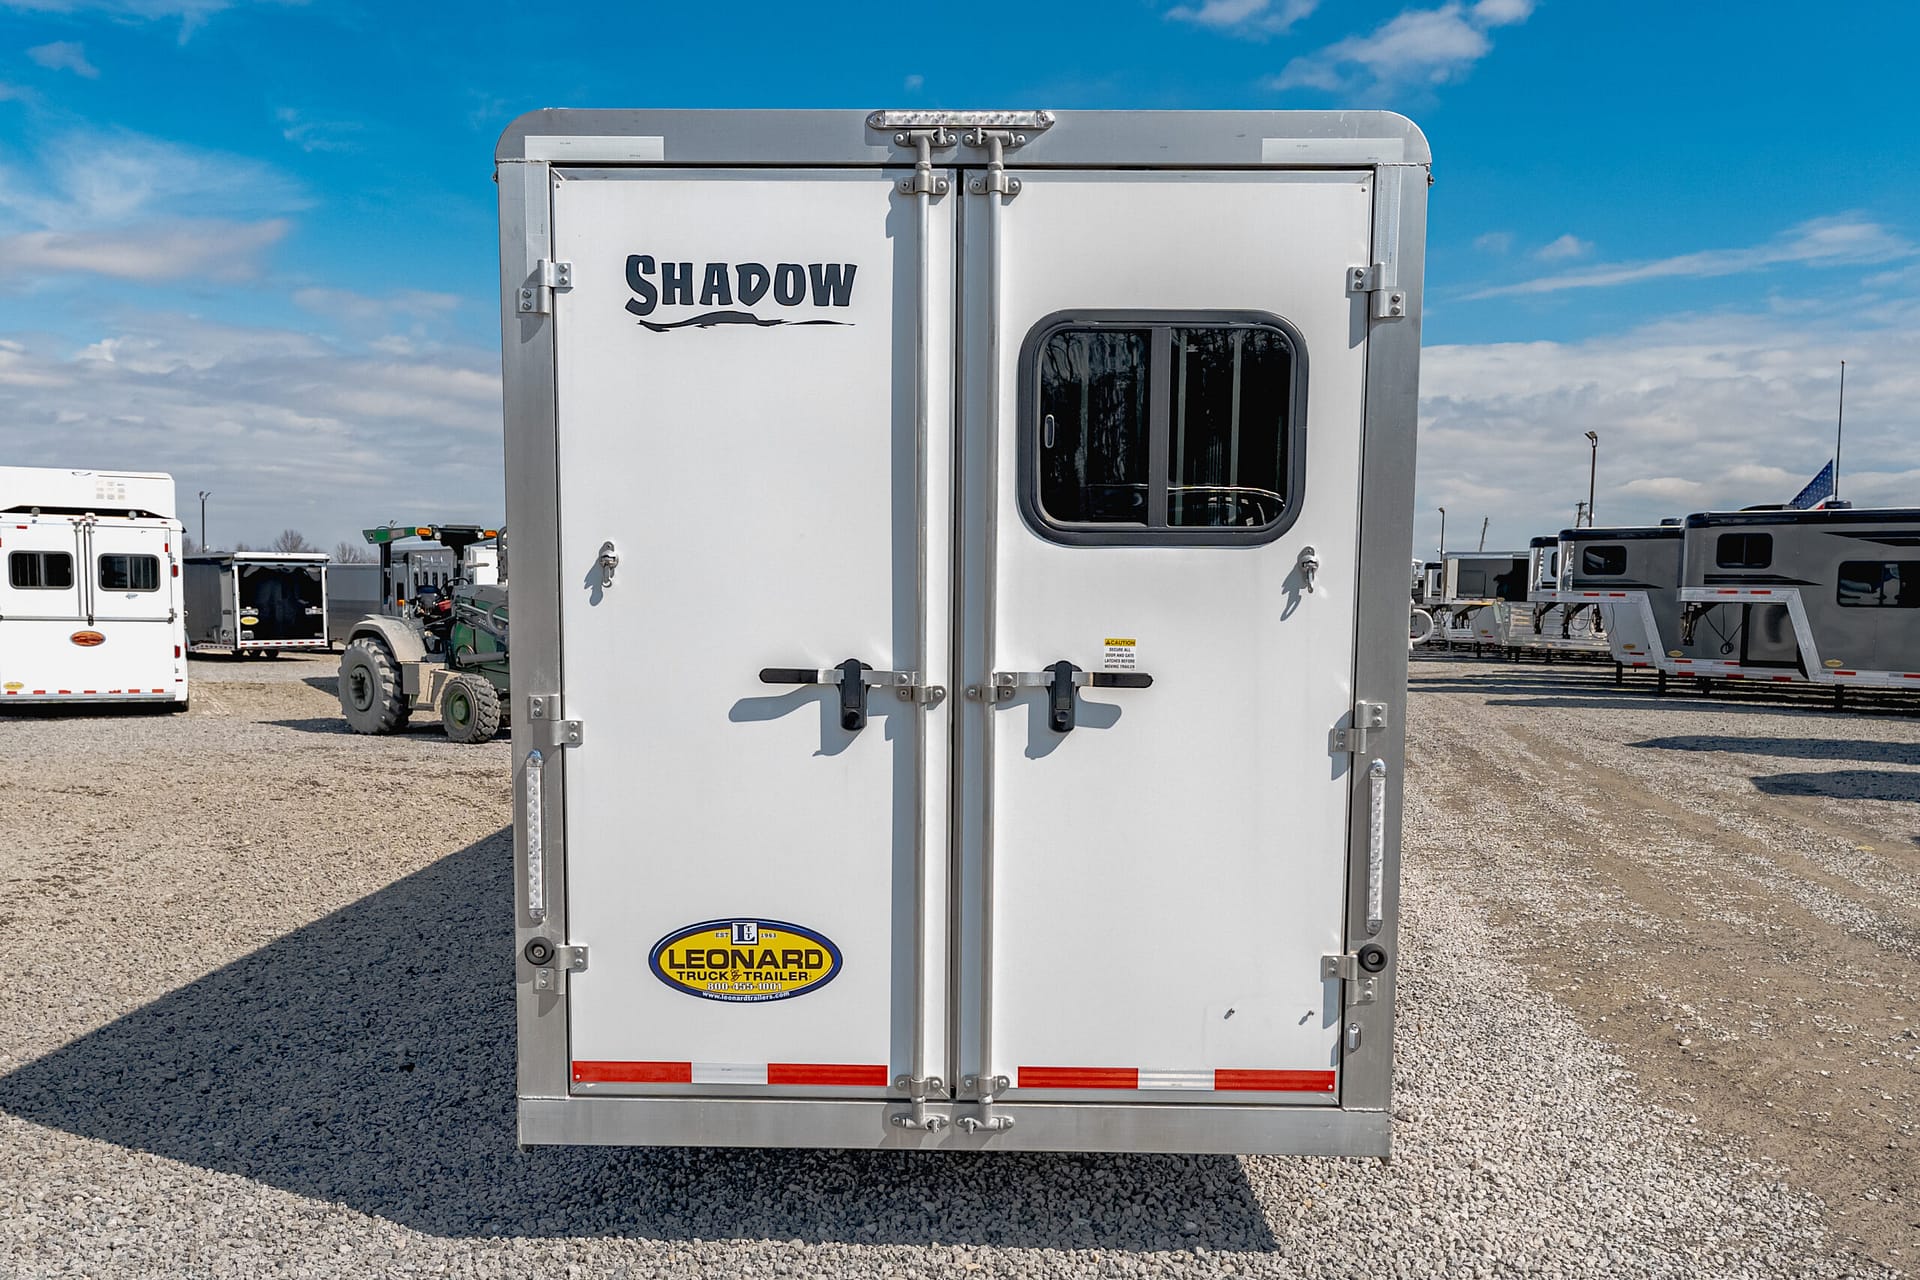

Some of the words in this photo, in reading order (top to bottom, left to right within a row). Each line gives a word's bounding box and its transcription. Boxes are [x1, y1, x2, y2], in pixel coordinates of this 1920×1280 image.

[668, 949, 824, 970] LEONARD
[676, 971, 729, 981] TRUCK
[743, 971, 808, 981] TRAILER
